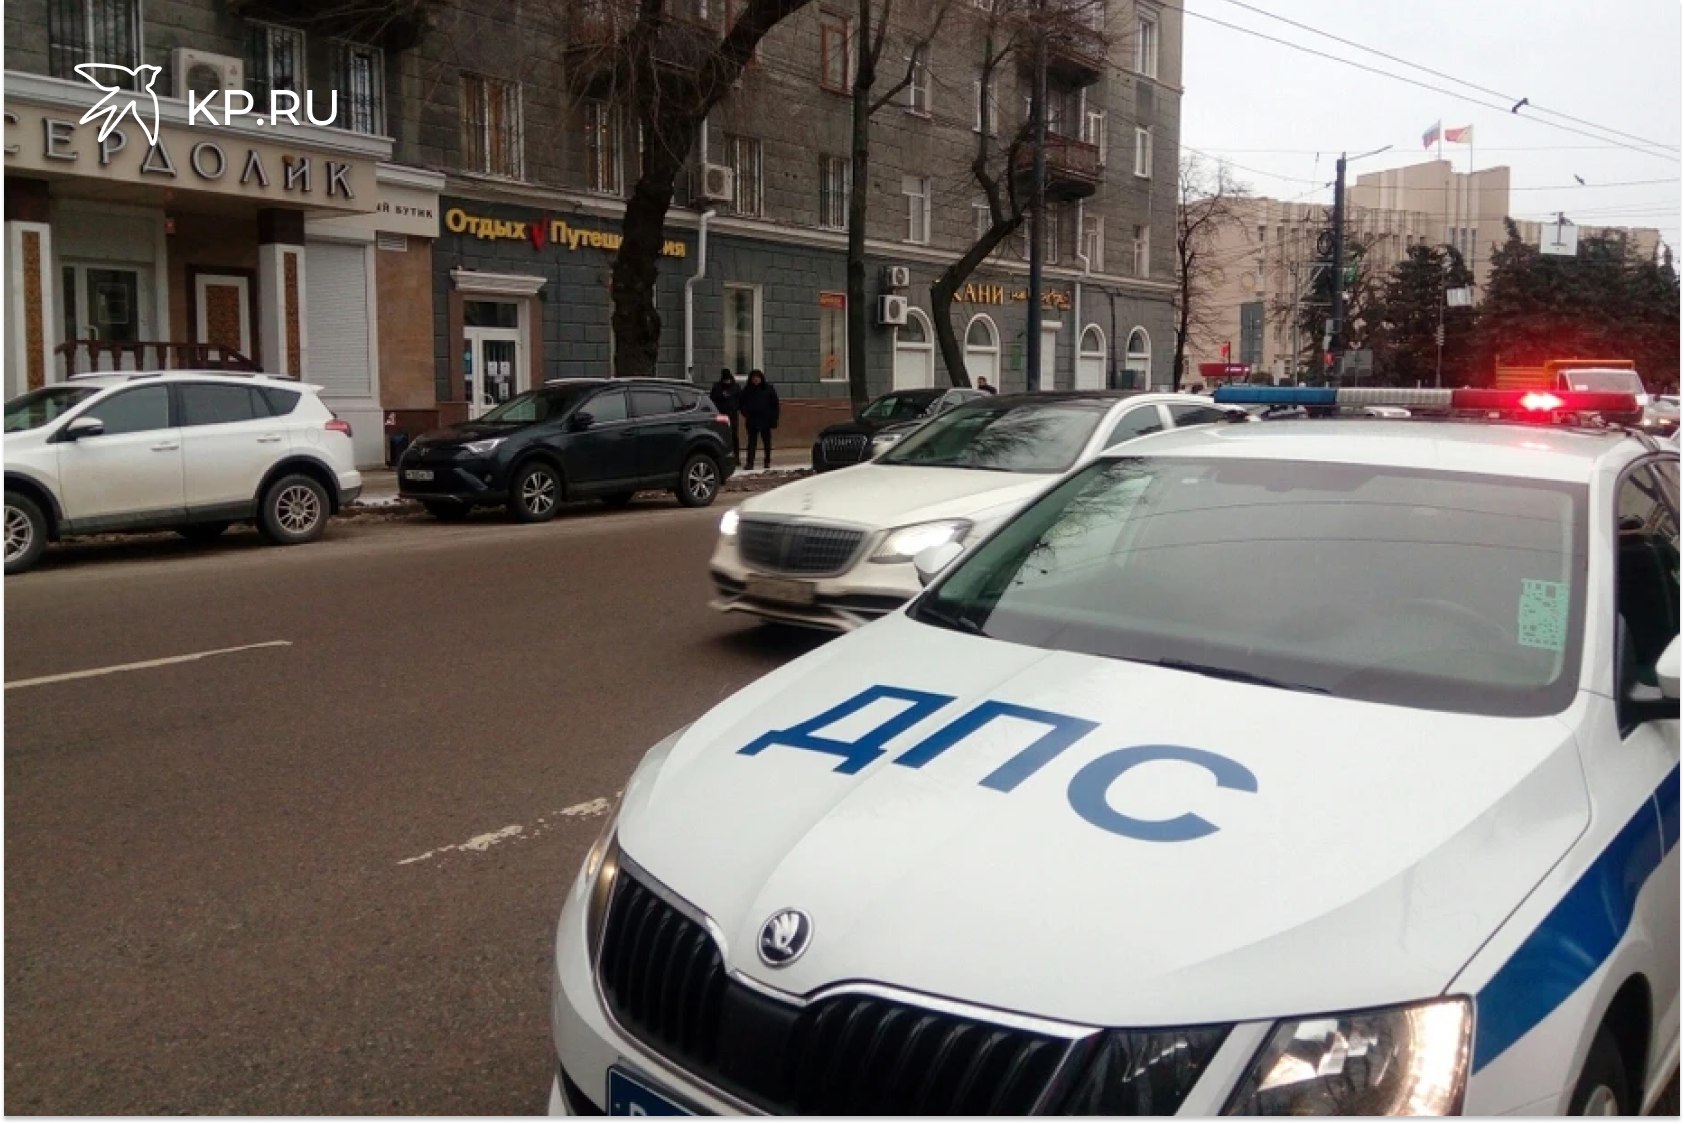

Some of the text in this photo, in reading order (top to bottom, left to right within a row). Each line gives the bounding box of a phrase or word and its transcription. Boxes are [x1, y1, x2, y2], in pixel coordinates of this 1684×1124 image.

[395, 205, 433, 219] БУТИК
[445, 207, 686, 258] Отдых Путешия
[736, 684, 1258, 842] ДПС
